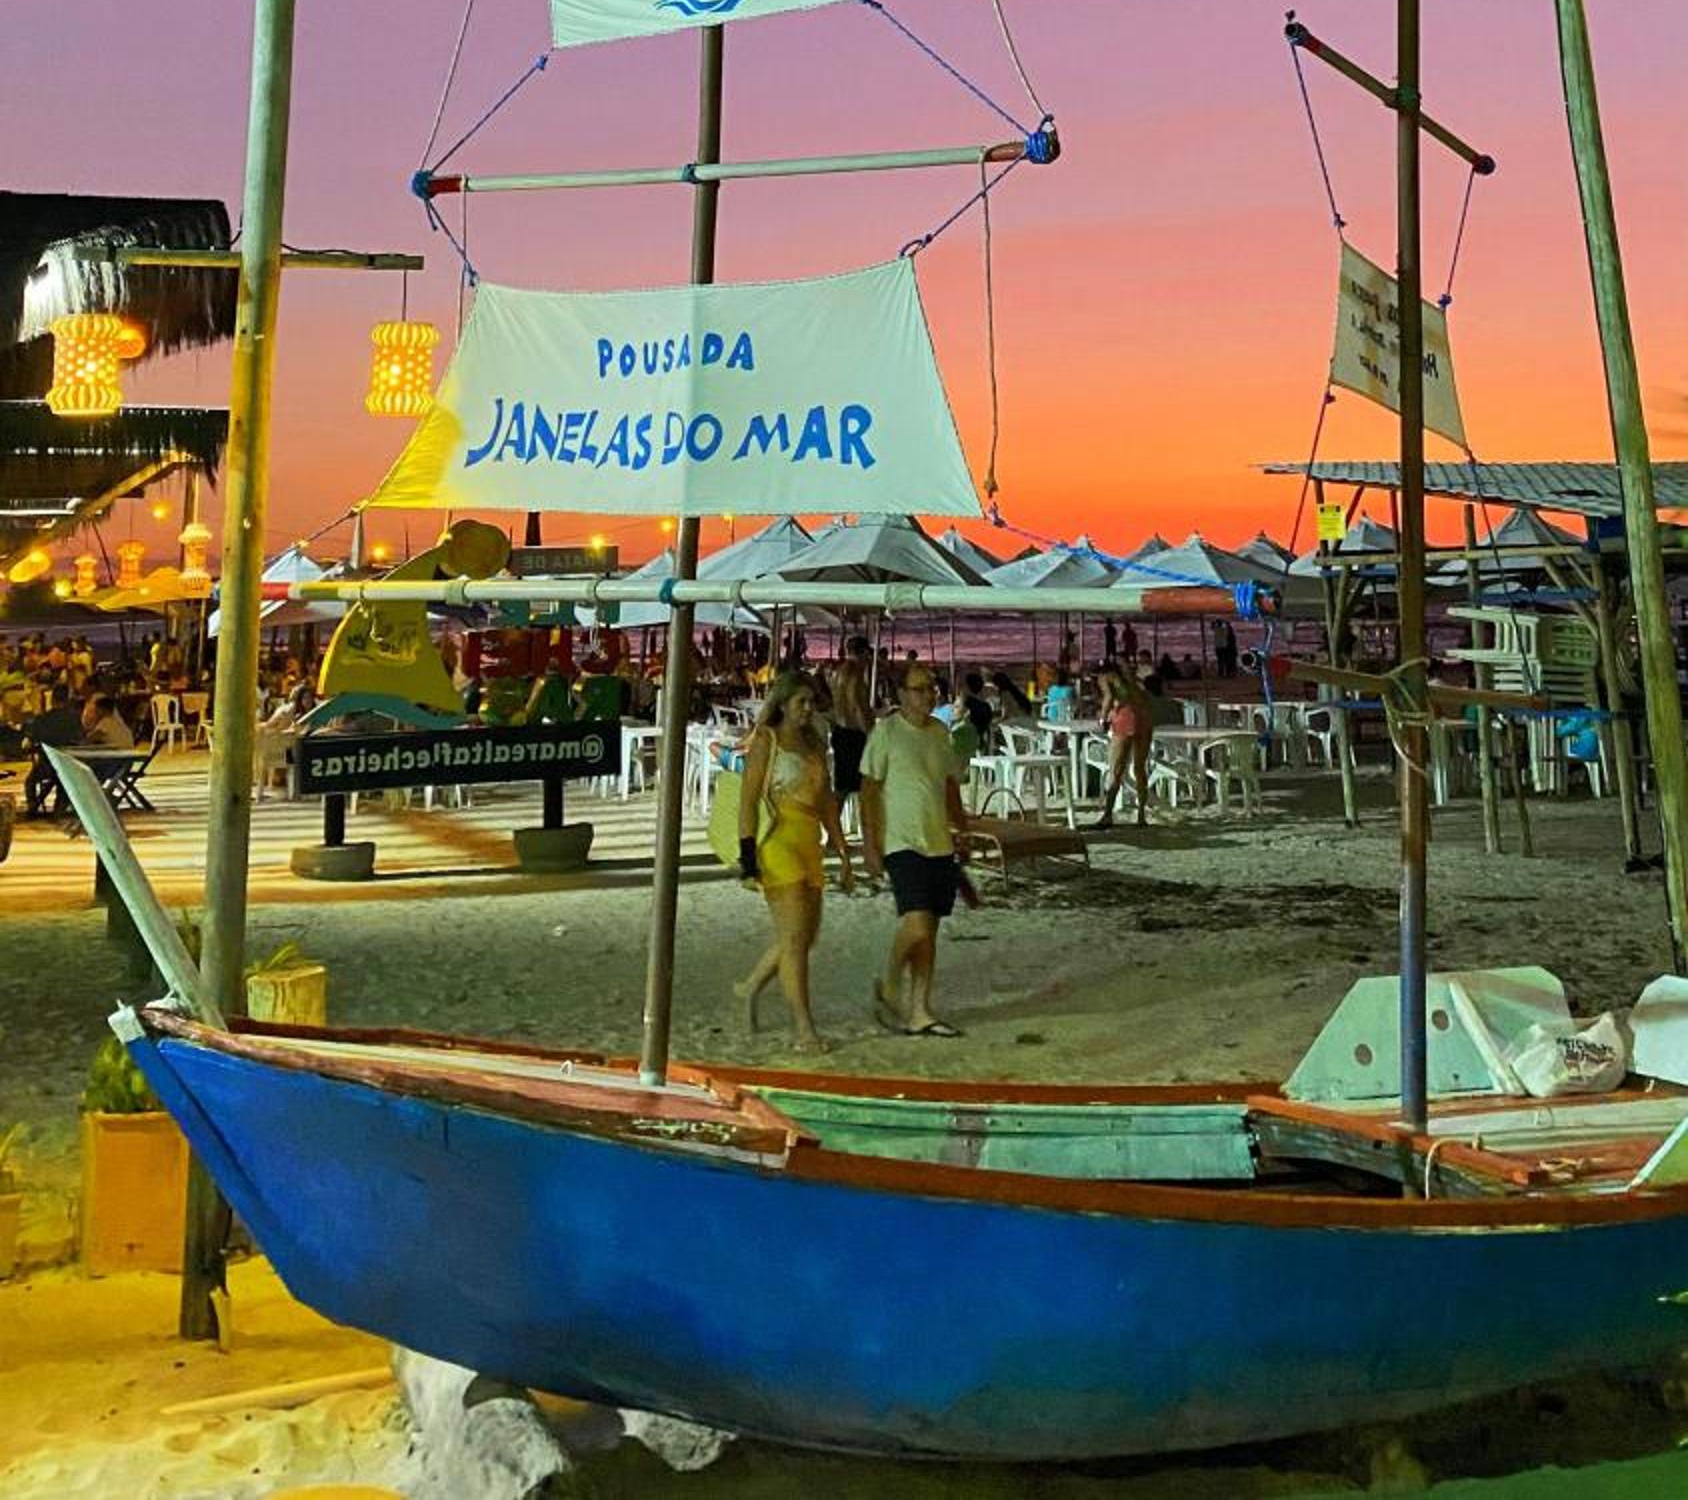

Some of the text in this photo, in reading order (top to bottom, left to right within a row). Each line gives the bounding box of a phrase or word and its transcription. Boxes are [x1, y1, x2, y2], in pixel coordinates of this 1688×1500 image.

[597, 331, 755, 378] POUSADA
[464, 398, 877, 471] JANELAS DO MAR
